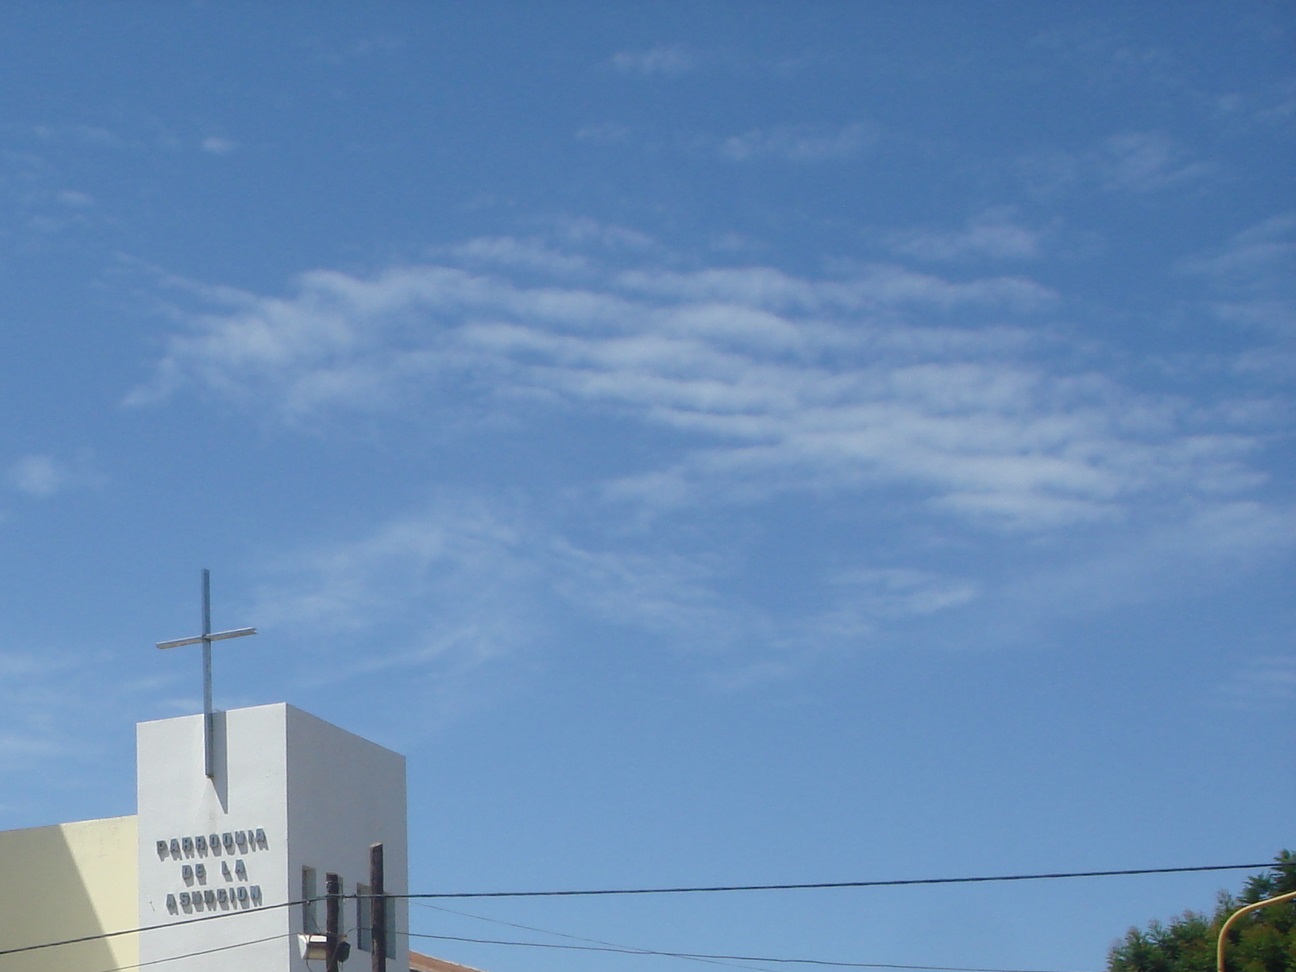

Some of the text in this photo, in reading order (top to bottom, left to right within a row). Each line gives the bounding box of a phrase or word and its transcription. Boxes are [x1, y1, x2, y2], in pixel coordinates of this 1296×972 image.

[156, 828, 267, 857] PARROQUIA
[182, 859, 246, 882] DE LA
